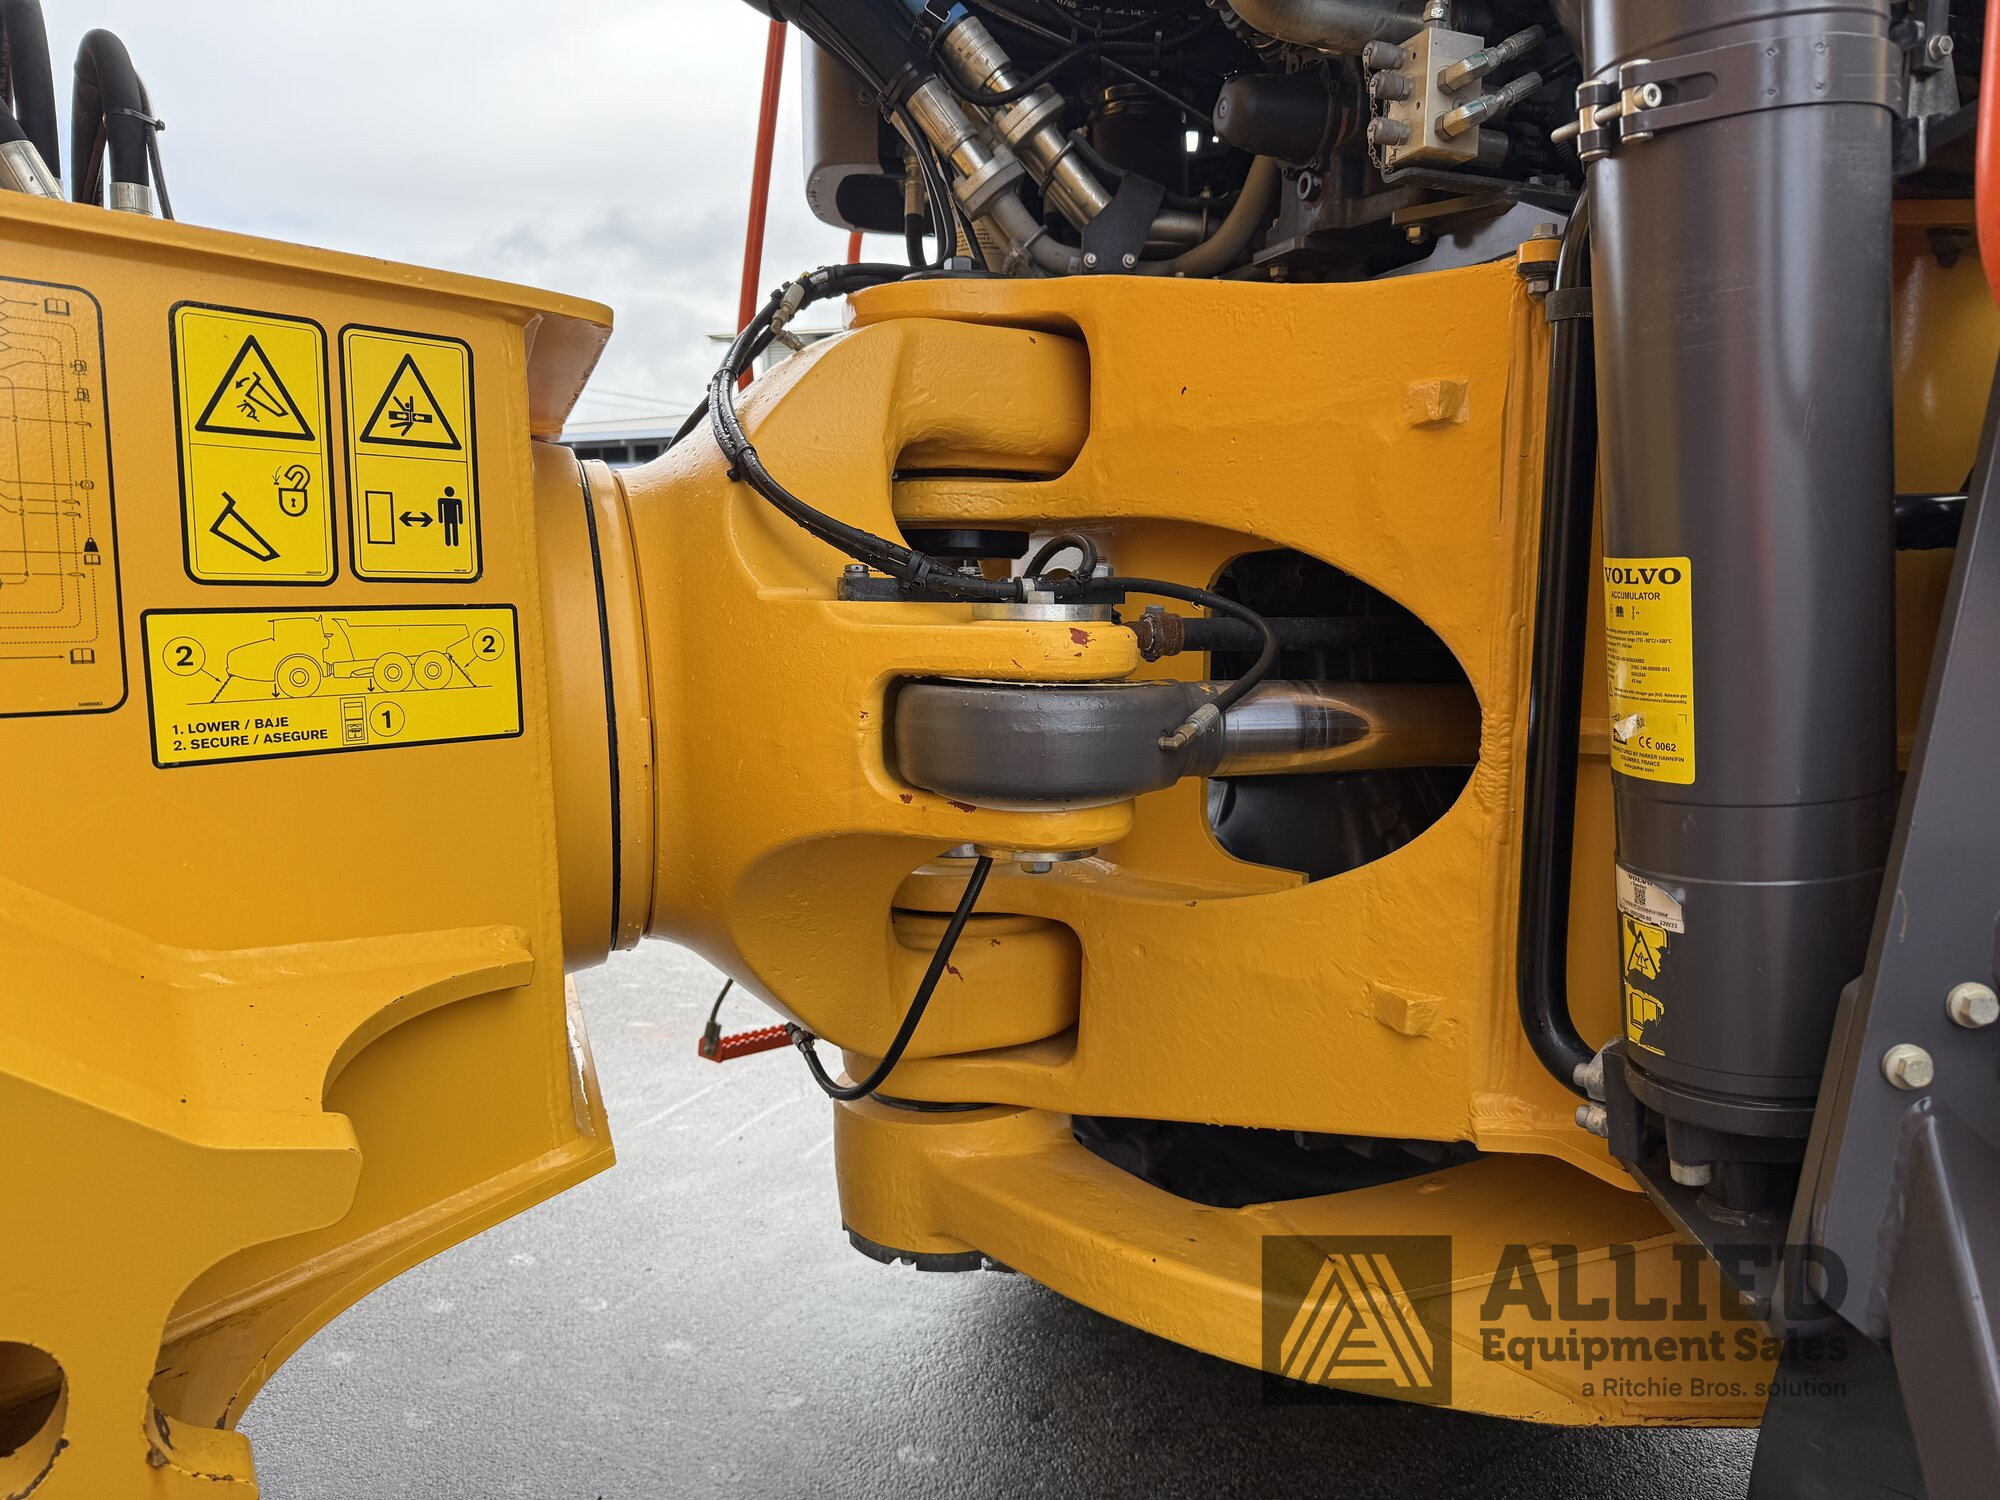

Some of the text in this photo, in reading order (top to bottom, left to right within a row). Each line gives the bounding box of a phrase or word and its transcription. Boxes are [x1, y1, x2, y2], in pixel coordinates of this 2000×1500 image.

[1605, 567, 1681, 585] VOLVO
[1611, 590, 1661, 600] ACCUMULATOR
[481, 634, 496, 653] 2
[176, 645, 194, 667] 2
[172, 716, 289, 735] 1. LOWER / BAJE
[381, 710, 392, 729] 1
[173, 729, 328, 751] 2. SECURE / ASEGURE
[1655, 742, 1676, 752] 0062
[1639, 752, 1658, 760] PARKER
[1658, 755, 1685, 763] HANNIFIN
[1641, 759, 1661, 767] FRANCE
